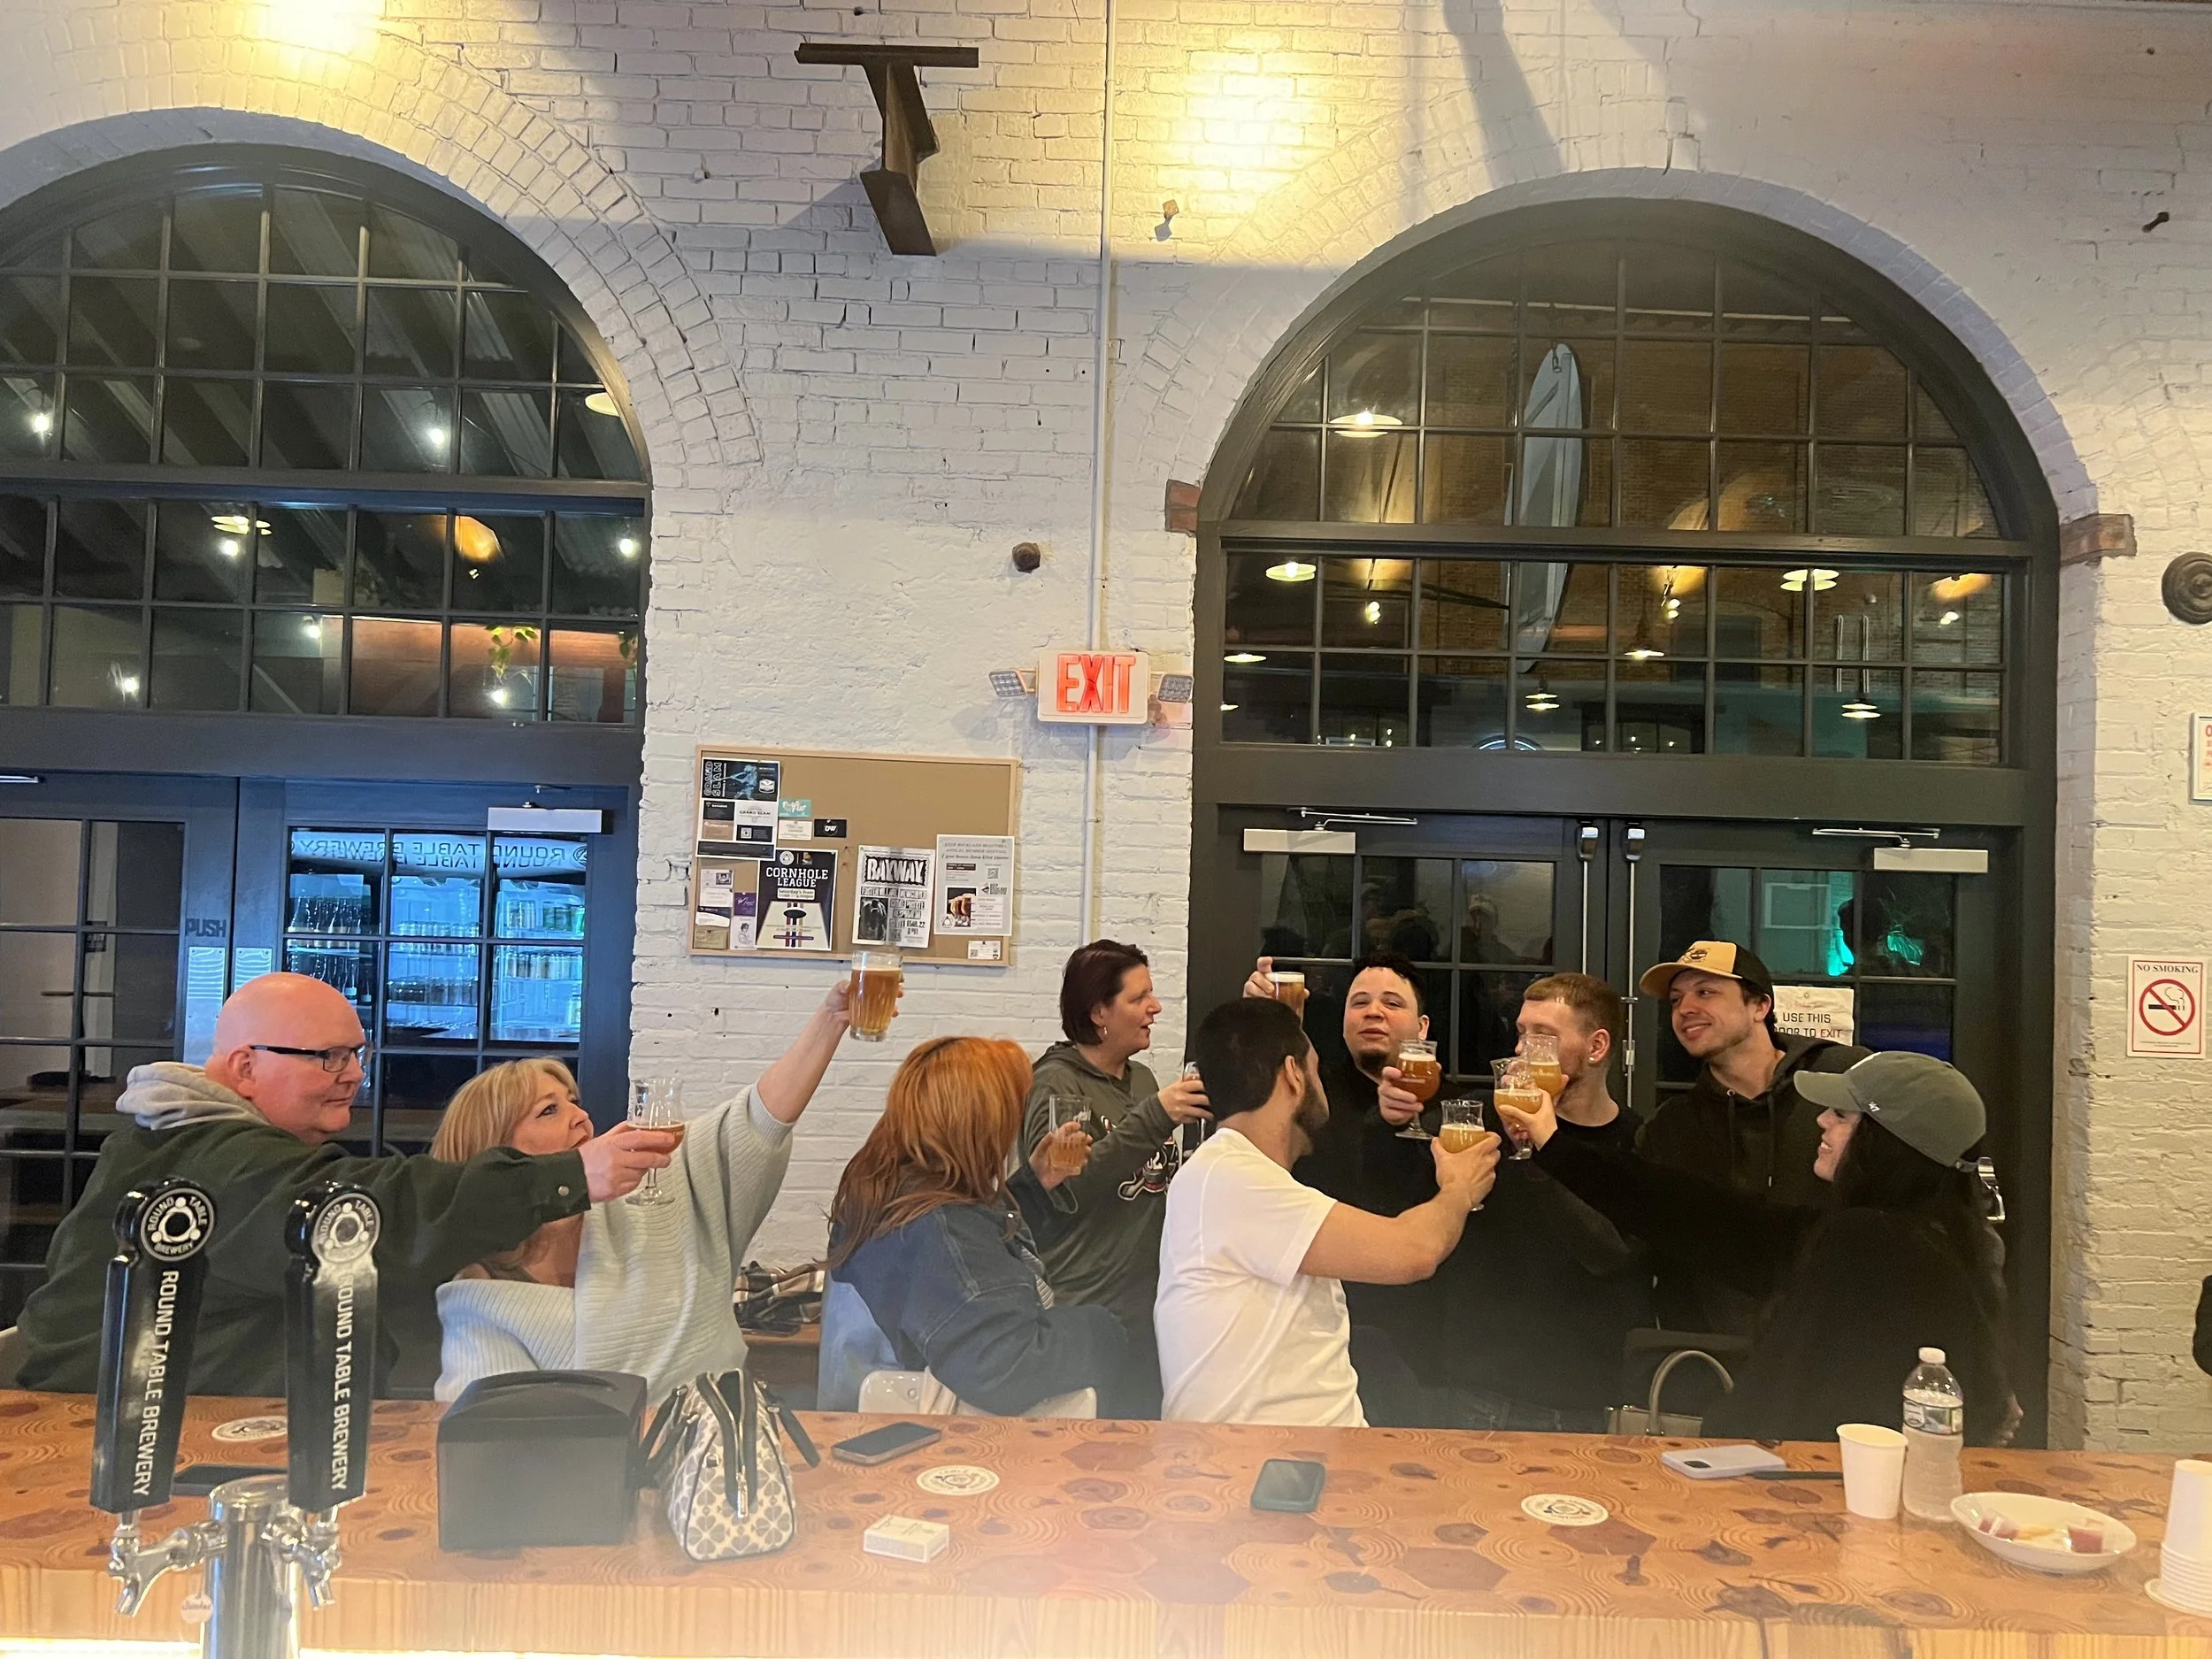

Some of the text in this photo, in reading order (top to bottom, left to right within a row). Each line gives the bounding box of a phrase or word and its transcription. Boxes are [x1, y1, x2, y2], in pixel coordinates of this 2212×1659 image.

[1056, 654, 1136, 713] EXIT
[712, 762, 722, 796] SLAM
[765, 867, 829, 879] CORNHOLE
[777, 878, 817, 887] LEAGUE
[185, 918, 227, 937] PUSH
[2152, 964, 2199, 973] SMOKING
[1783, 1012, 1832, 1023] USE THIS
[1802, 1028, 1816, 1037] TO
[1820, 1029, 1843, 1038] EXIT
[147, 1195, 208, 1231] ROUND TABLE
[133, 1270, 180, 1496] ROUND TABLE BREWERY
[331, 1273, 354, 1490] ROUND TABLE BREWERY
